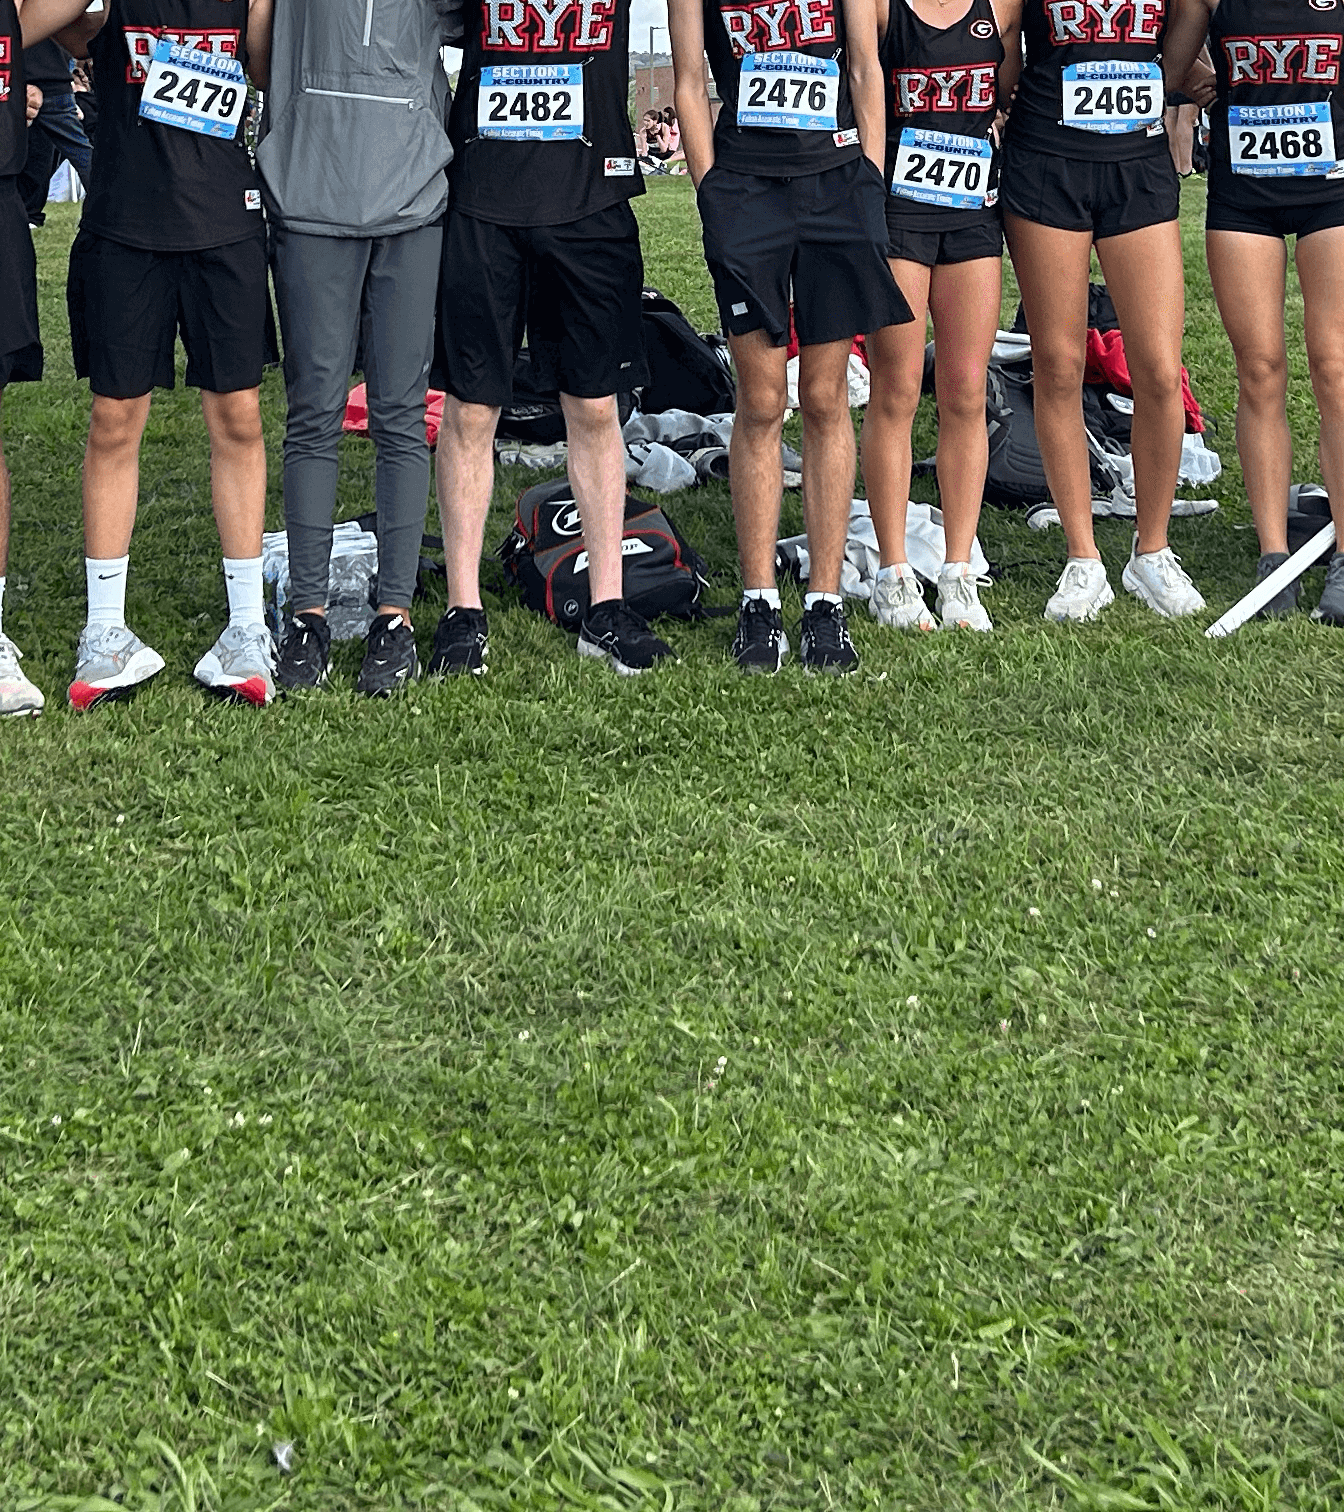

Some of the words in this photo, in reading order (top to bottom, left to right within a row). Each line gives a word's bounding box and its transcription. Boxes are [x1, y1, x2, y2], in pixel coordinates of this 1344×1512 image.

[168, 57, 243, 81] X-COUNTRY
[170, 46, 240, 73] SECTION
[753, 64, 827, 75] X-COUNTRY
[754, 52, 815, 65] SECTION
[1076, 63, 1140, 73] SECTION
[1221, 34, 1343, 86] RYE
[492, 67, 556, 78] SECTION
[153, 70, 237, 118] 2479
[748, 77, 826, 111] 2476
[893, 63, 997, 116] RYE
[1074, 86, 1152, 115] 2465
[488, 91, 572, 121] 2482
[1240, 106, 1306, 118] SECTION
[1240, 116, 1318, 125] X-COUNTRY
[914, 130, 975, 148] SECTION
[914, 141, 983, 156] X-COUNTRY
[1239, 129, 1322, 159] 2468
[904, 154, 980, 190] 2470
